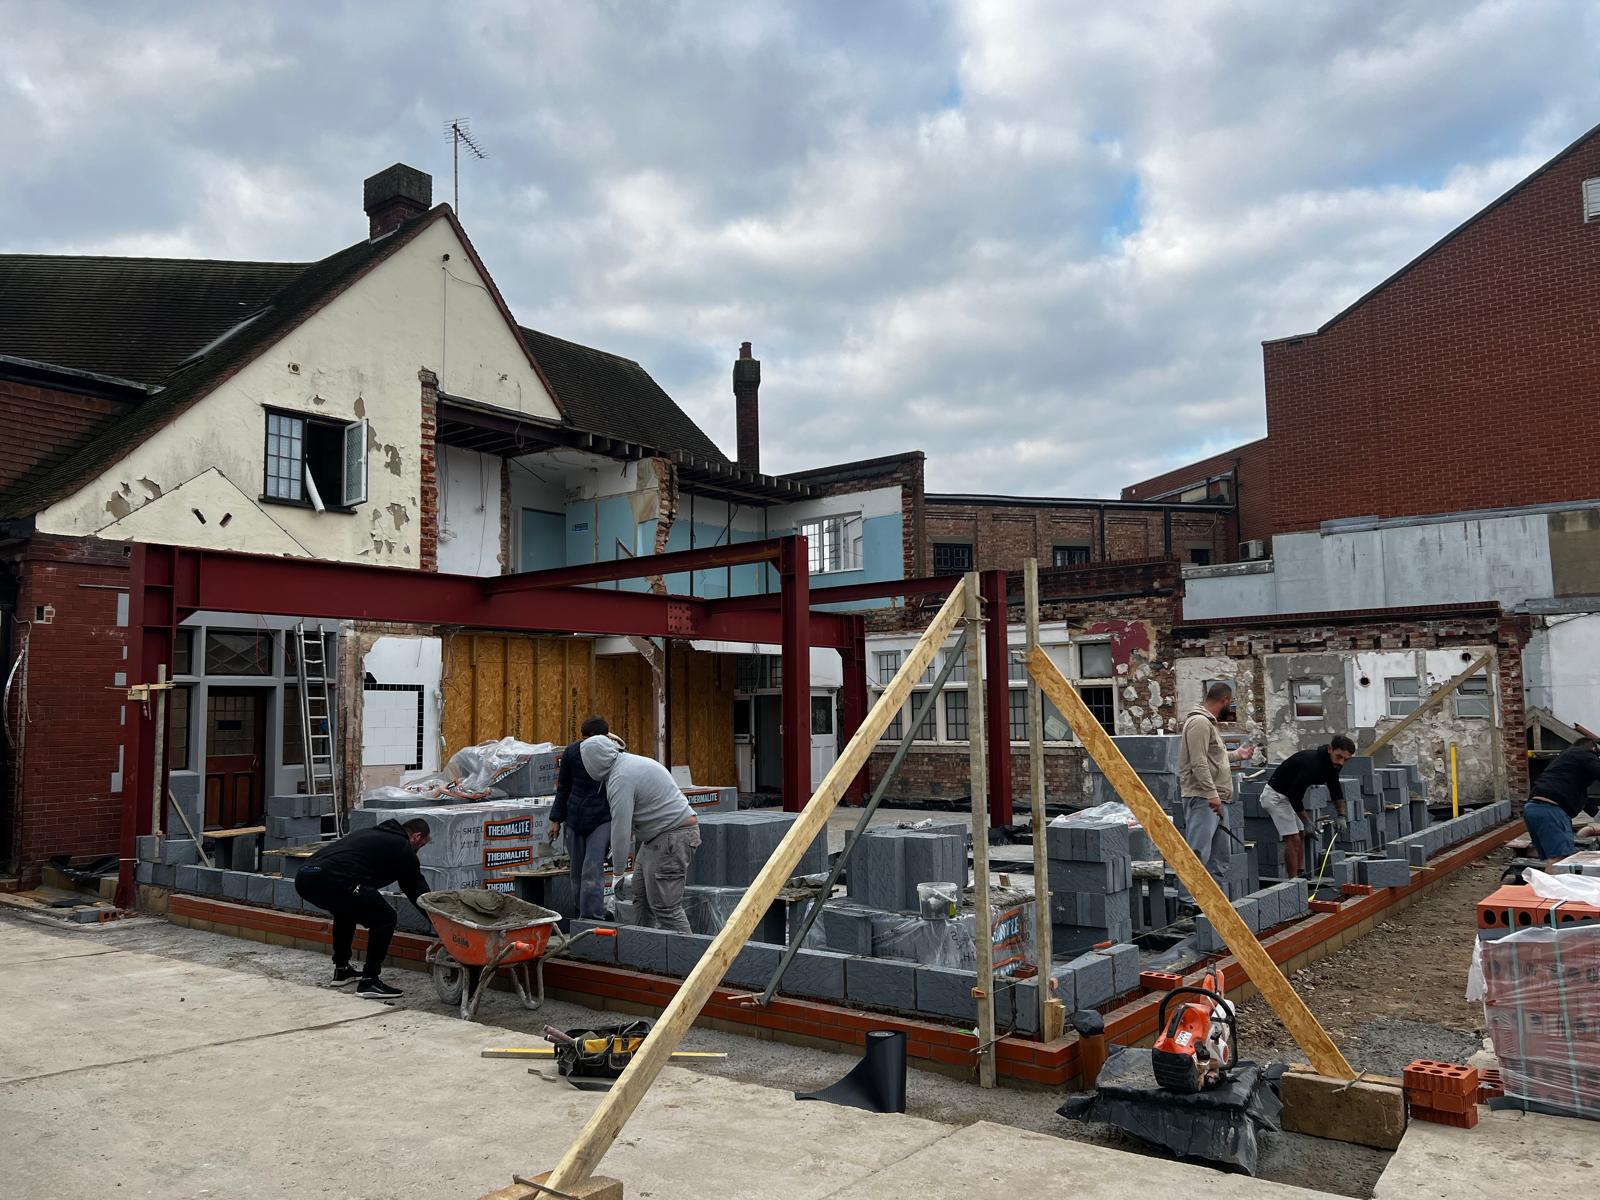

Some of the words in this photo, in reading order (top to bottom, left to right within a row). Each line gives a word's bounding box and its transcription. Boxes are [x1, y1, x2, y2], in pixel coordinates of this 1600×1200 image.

[687, 793, 718, 804] THERMALITE
[488, 820, 530, 836] THERMALITE
[487, 850, 530, 862] THERMALITE
